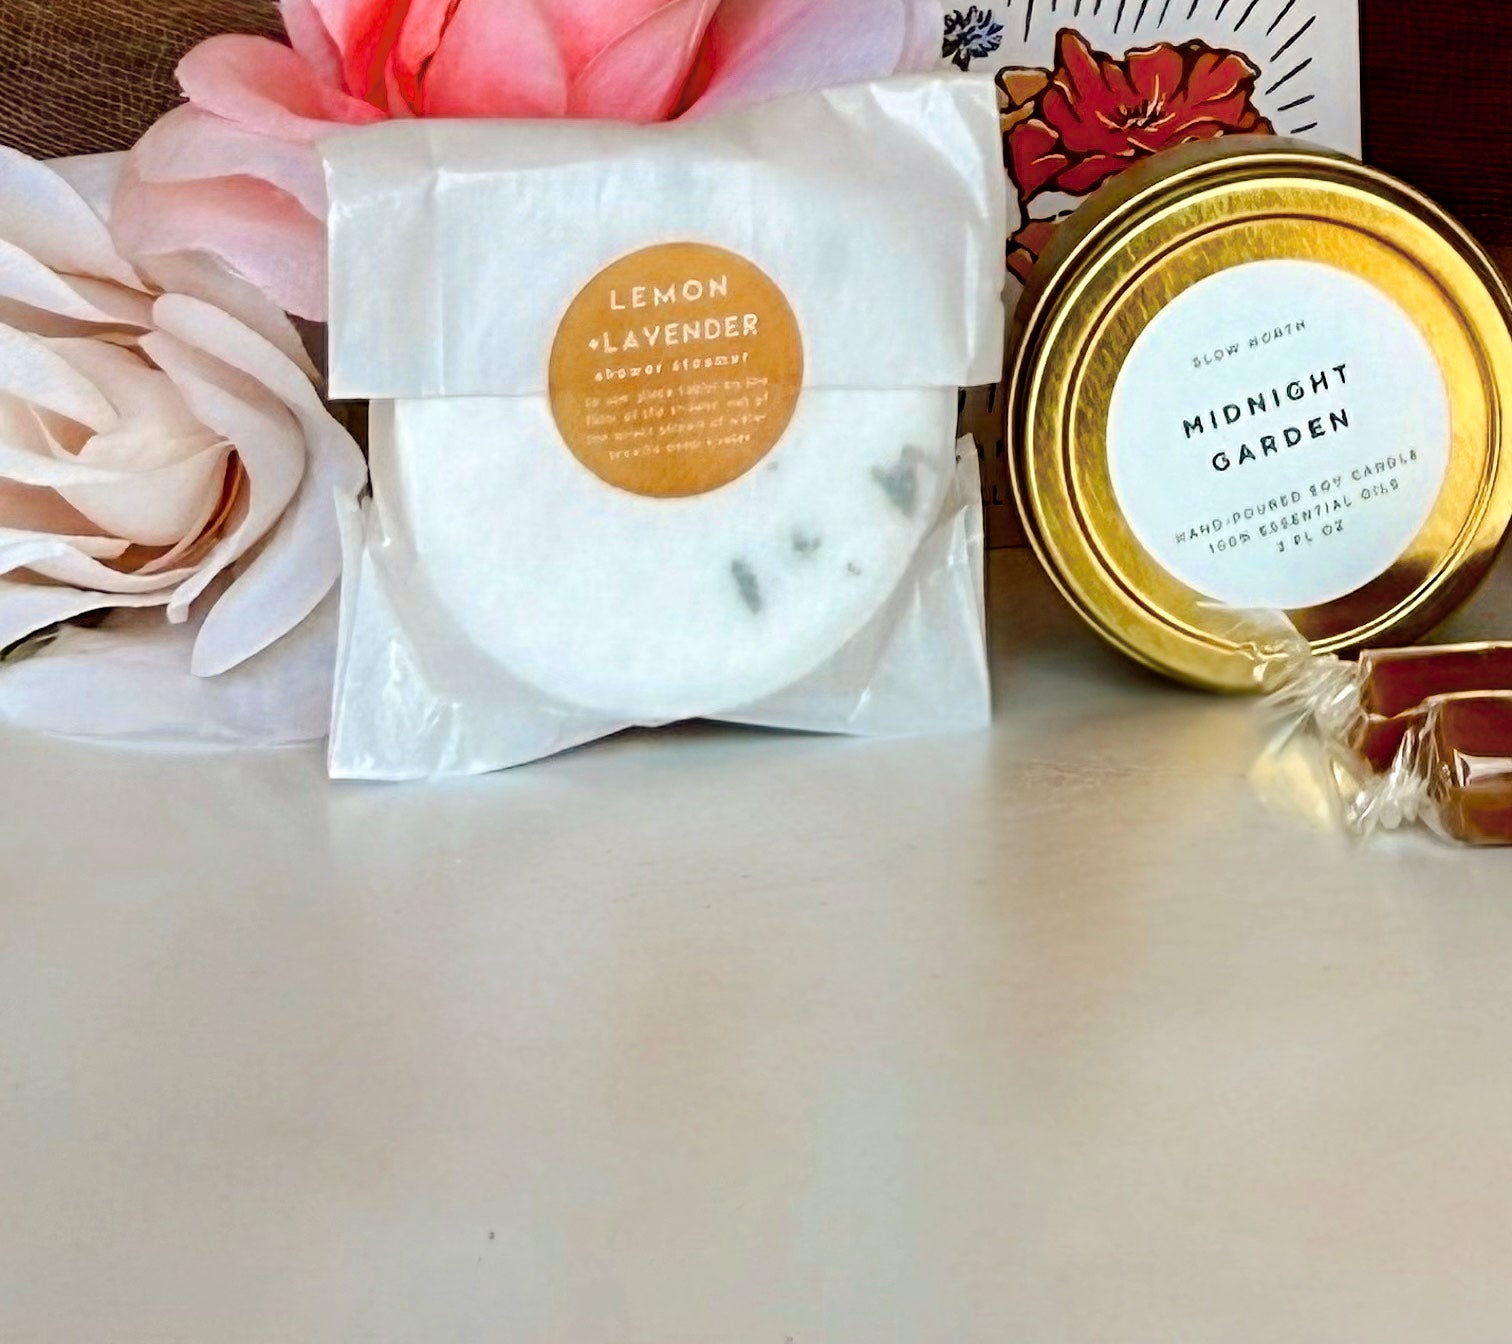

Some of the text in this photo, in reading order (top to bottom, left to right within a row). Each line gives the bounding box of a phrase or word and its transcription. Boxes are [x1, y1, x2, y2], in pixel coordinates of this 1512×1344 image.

[609, 274, 728, 311] LEMON
[1182, 363, 1347, 439] MIDNIGHT
[1211, 408, 1350, 472] GARDEN
